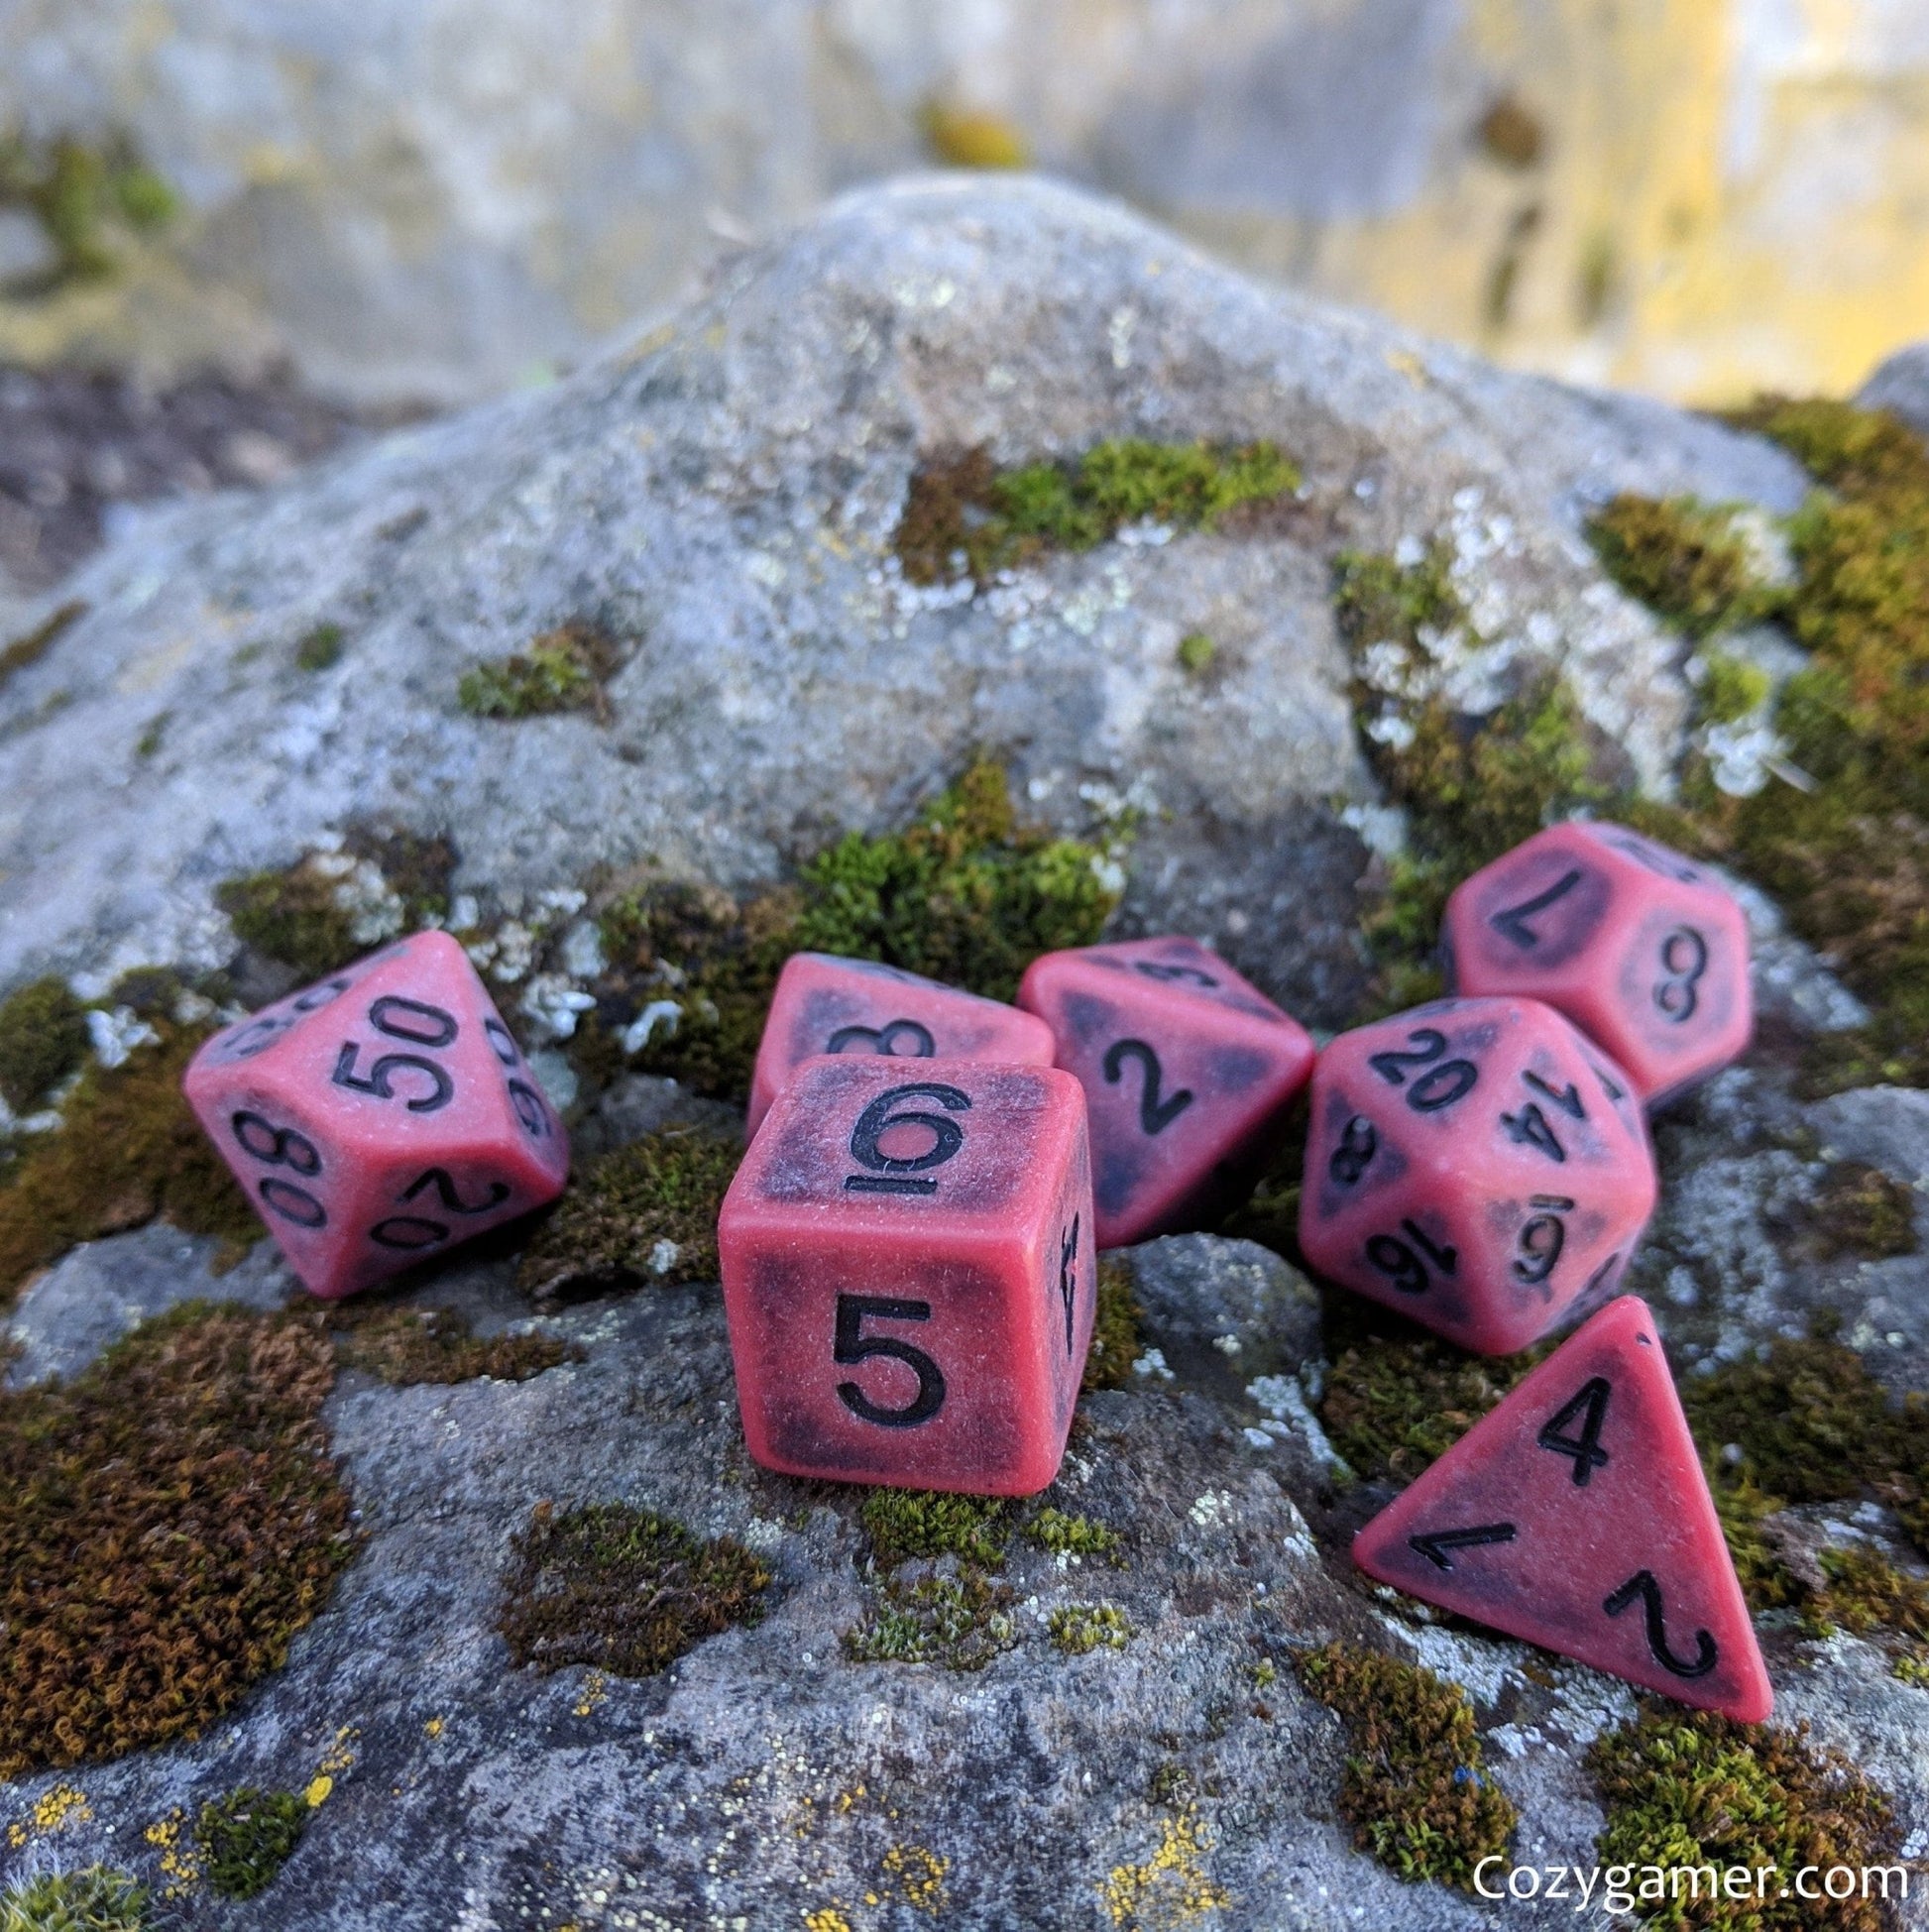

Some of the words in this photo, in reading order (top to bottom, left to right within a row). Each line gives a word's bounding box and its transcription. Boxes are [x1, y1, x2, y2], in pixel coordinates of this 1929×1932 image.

[1490, 870, 1582, 948] 7
[1653, 926, 1708, 1022] 8
[331, 995, 460, 1113] 50
[1103, 1038, 1193, 1136] 2
[1368, 1028, 1479, 1113] 20
[845, 1082, 973, 1194] 6
[1329, 1114, 1377, 1185] 8
[1499, 1069, 1586, 1164] 14
[232, 1110, 328, 1228] 80
[370, 1167, 511, 1251] 20
[1365, 1217, 1458, 1295] 16
[834, 1293, 947, 1428] 5
[1536, 1376, 1614, 1486] 4
[1409, 1522, 1518, 1571] 1
[1602, 1569, 1718, 1678] 2
